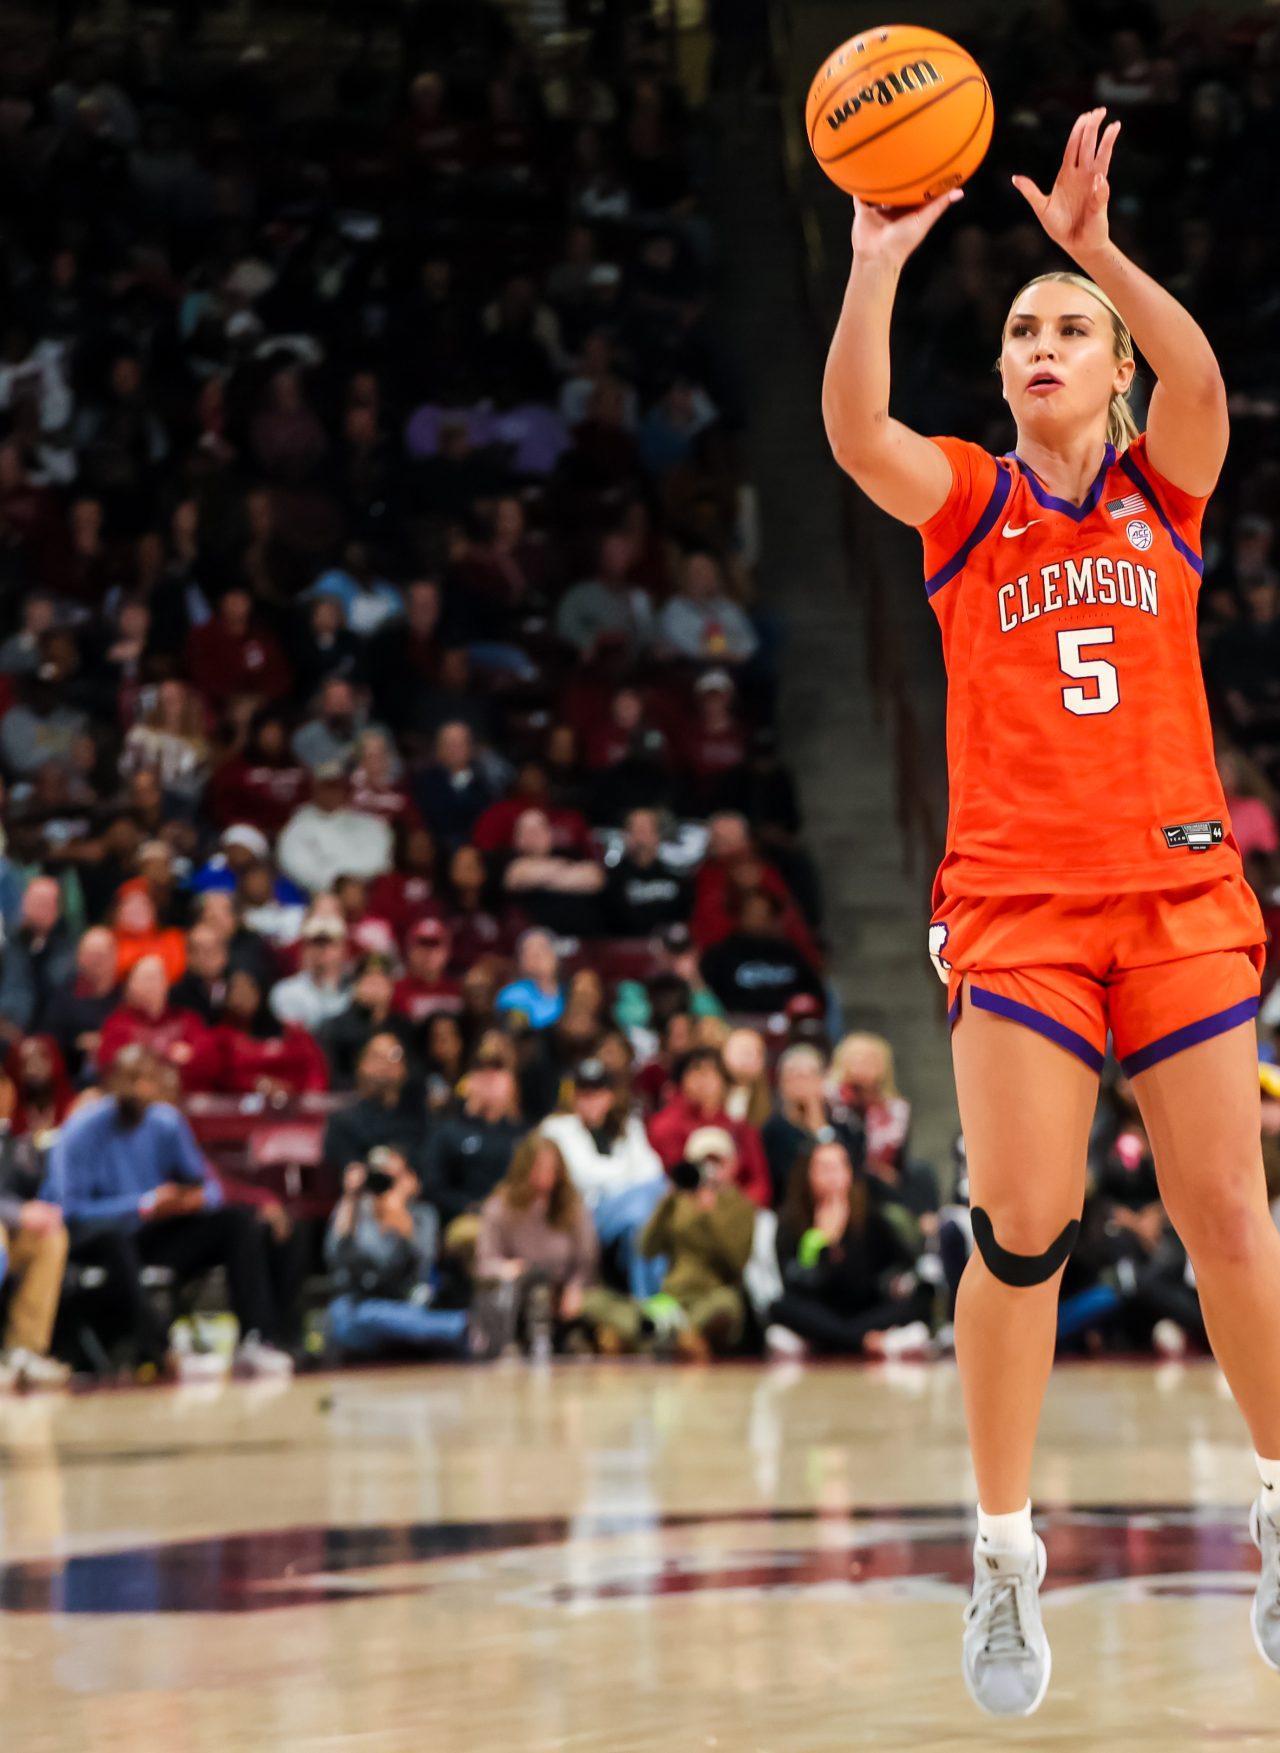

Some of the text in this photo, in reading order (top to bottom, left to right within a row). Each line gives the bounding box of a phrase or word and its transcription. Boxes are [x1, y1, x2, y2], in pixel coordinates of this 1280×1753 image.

[827, 59, 940, 131] Wilson
[998, 557, 1159, 633] CLEMSON
[1056, 625, 1120, 716] 5
[1213, 827, 1222, 837] 44
